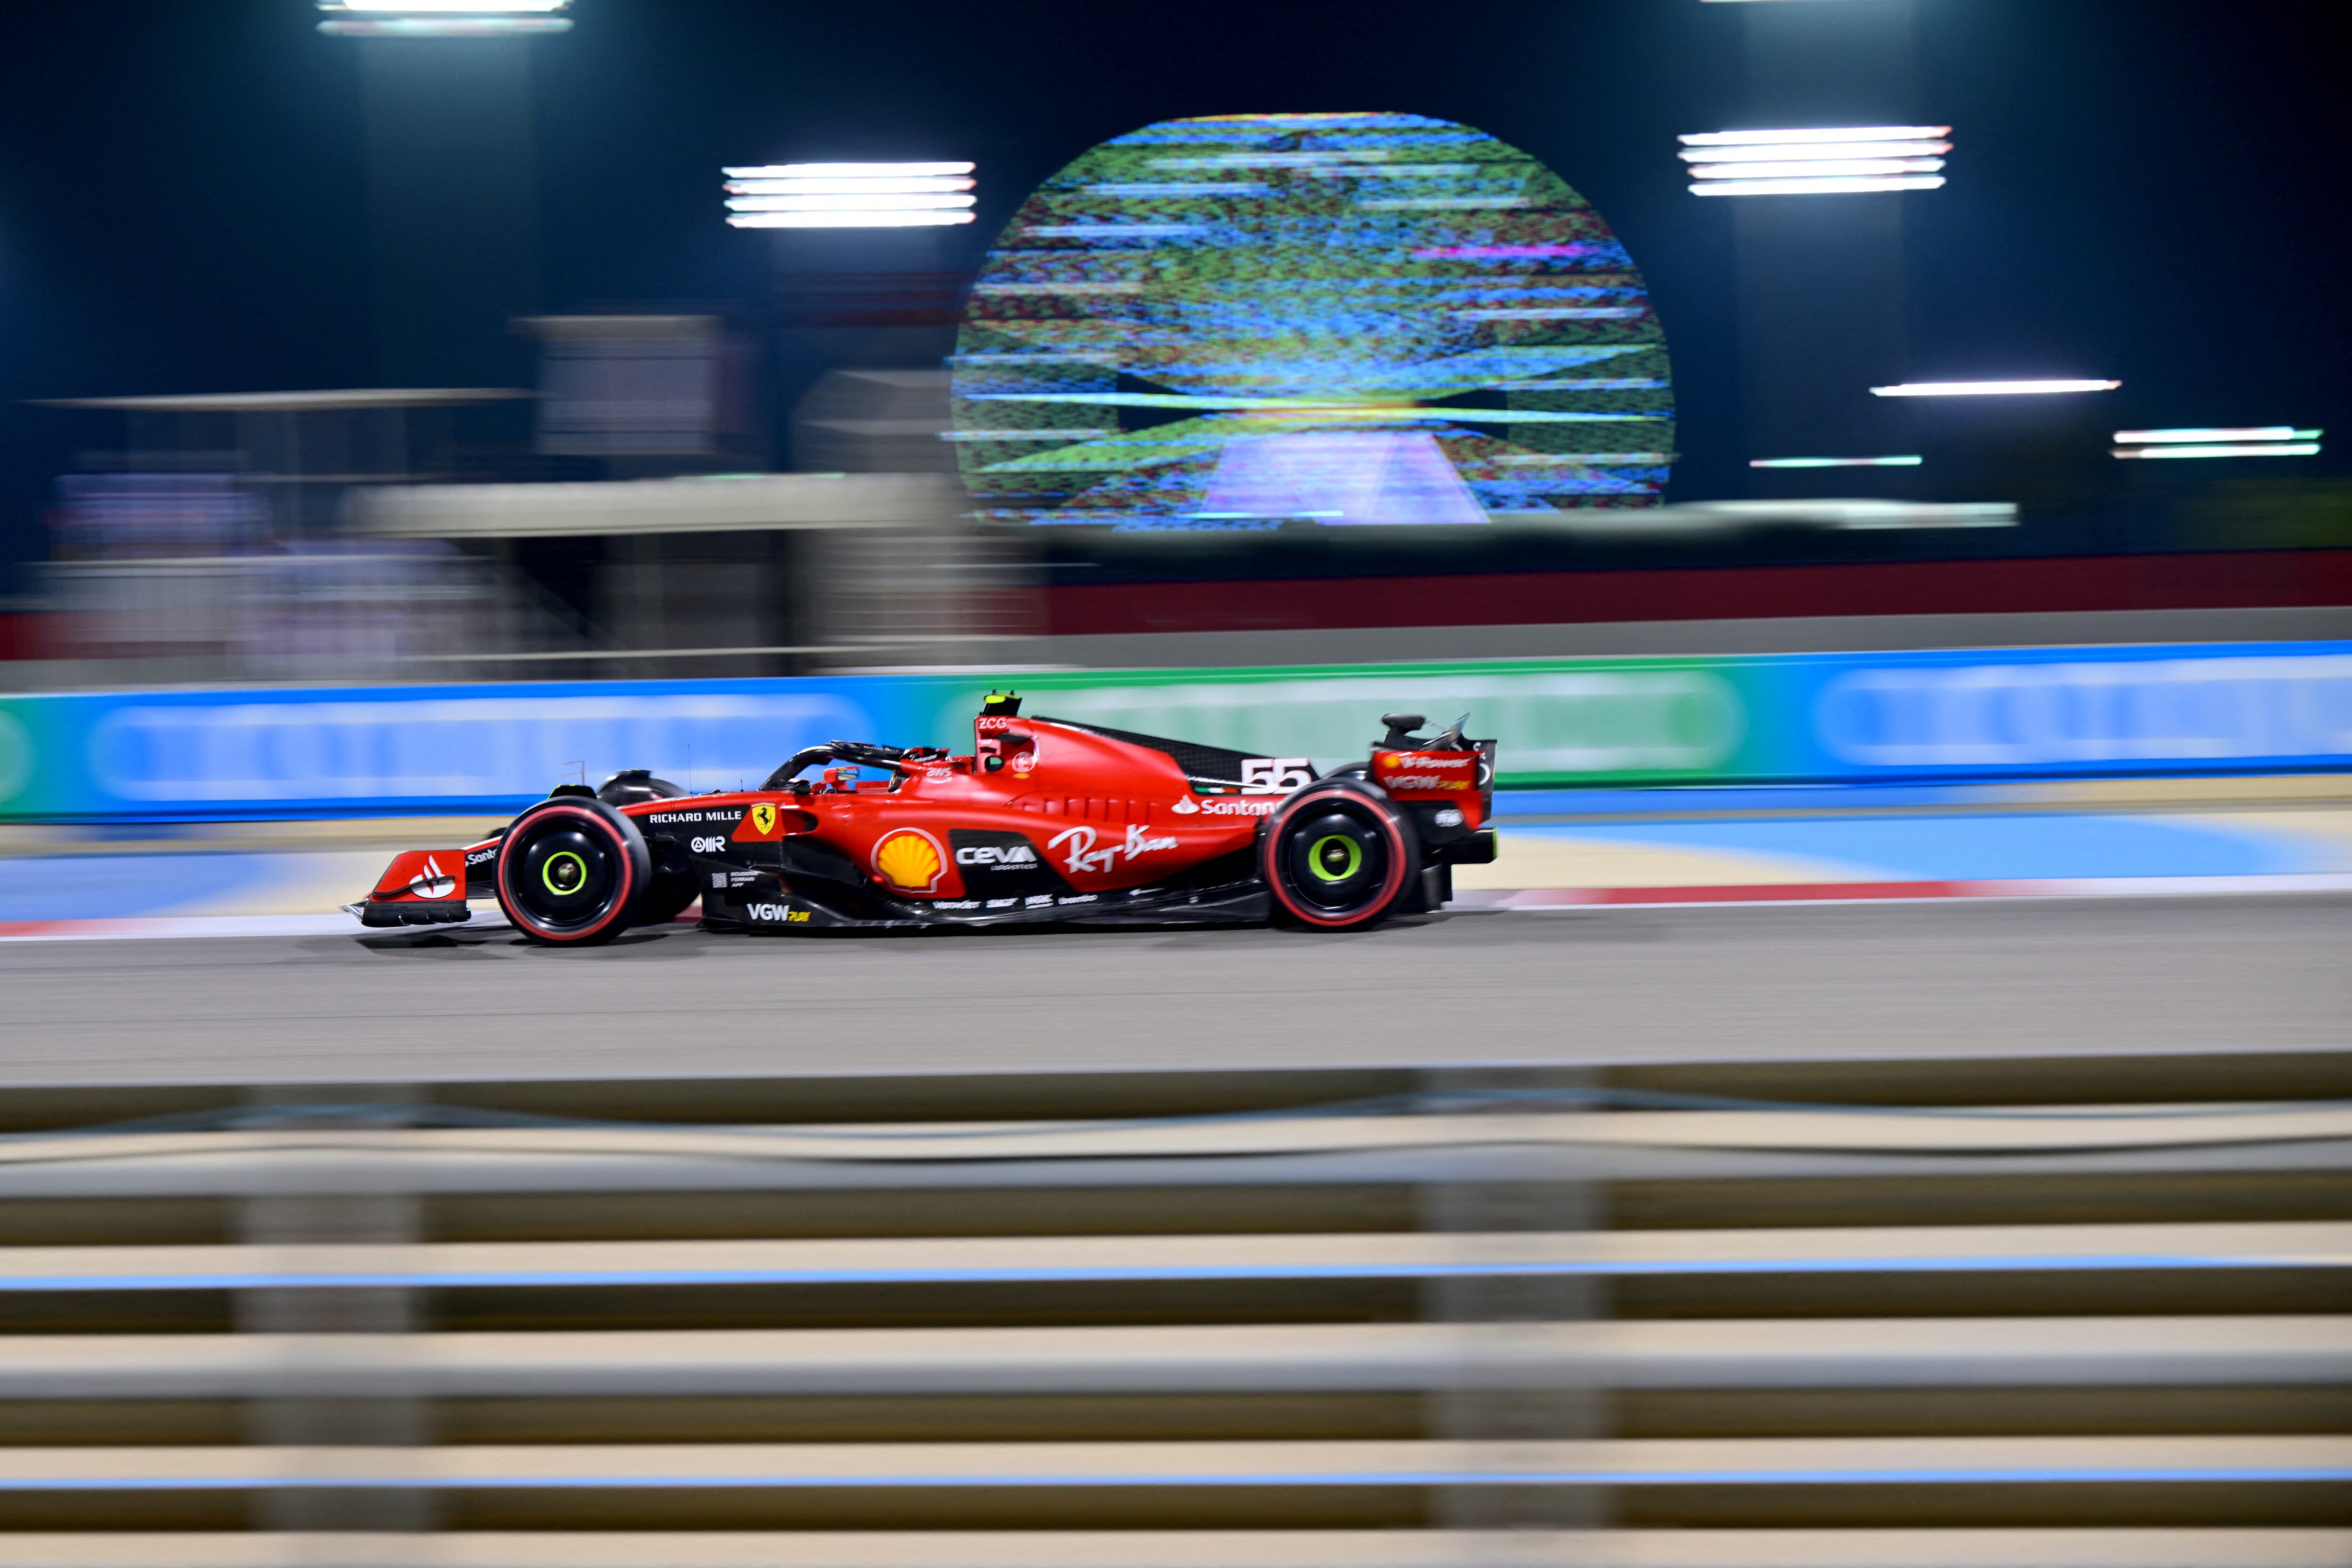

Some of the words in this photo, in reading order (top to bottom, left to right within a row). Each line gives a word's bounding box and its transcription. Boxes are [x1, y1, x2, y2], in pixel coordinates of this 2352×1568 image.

[978, 717, 1007, 729] ZCG
[926, 767, 952, 777] aws
[1241, 757, 1312, 795] 55
[650, 812, 702, 823] RICHARD
[707, 811, 742, 821] MILLE
[746, 903, 790, 921] VGW
